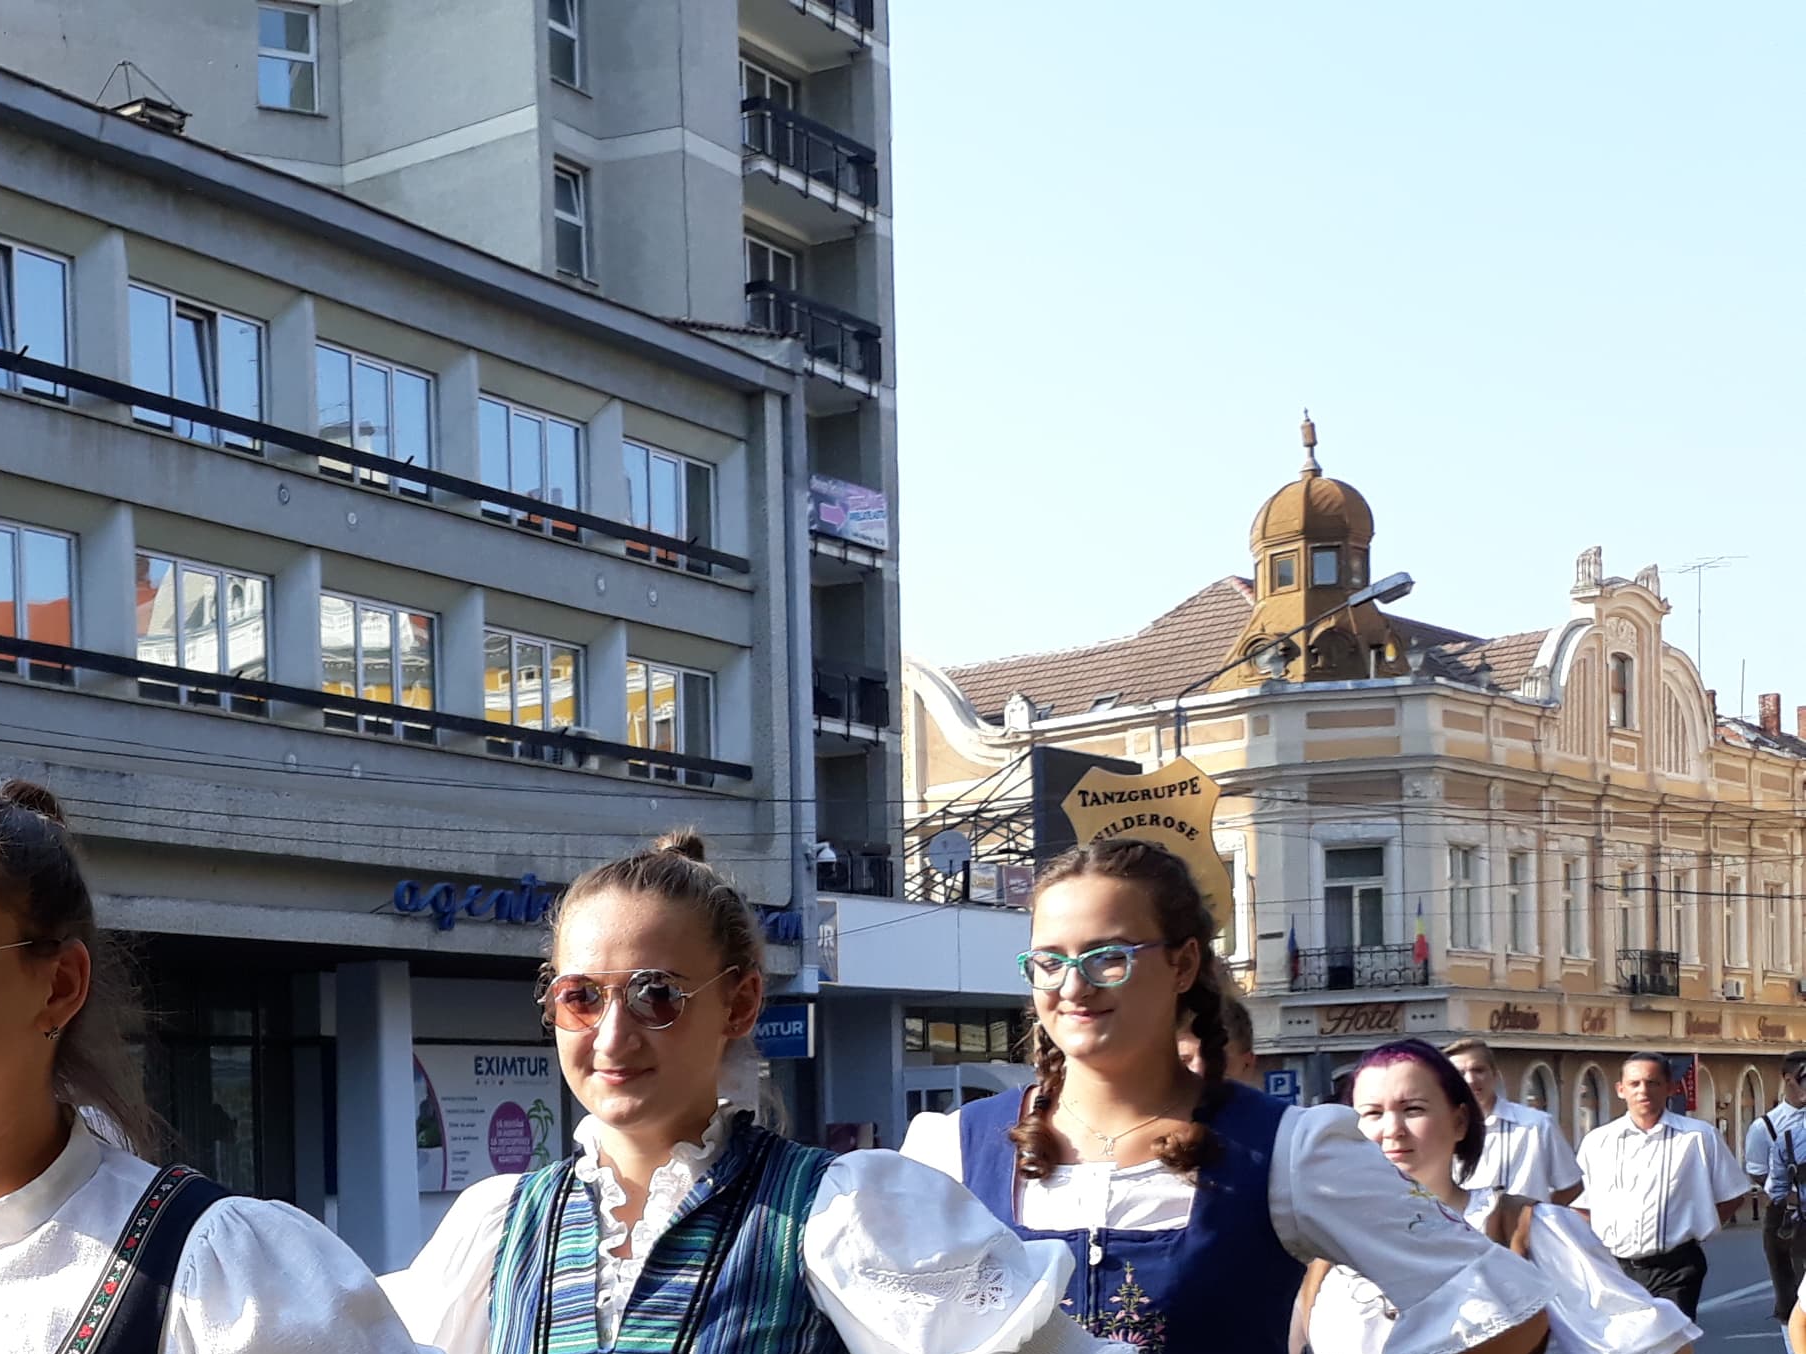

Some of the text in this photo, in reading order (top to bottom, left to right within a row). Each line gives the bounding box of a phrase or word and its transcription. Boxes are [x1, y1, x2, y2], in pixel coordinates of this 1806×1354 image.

[1078, 776, 1201, 807] TANZGRUPPE
[1320, 1002, 1398, 1034] Hotel
[473, 1055, 550, 1077] EXIMTUR
